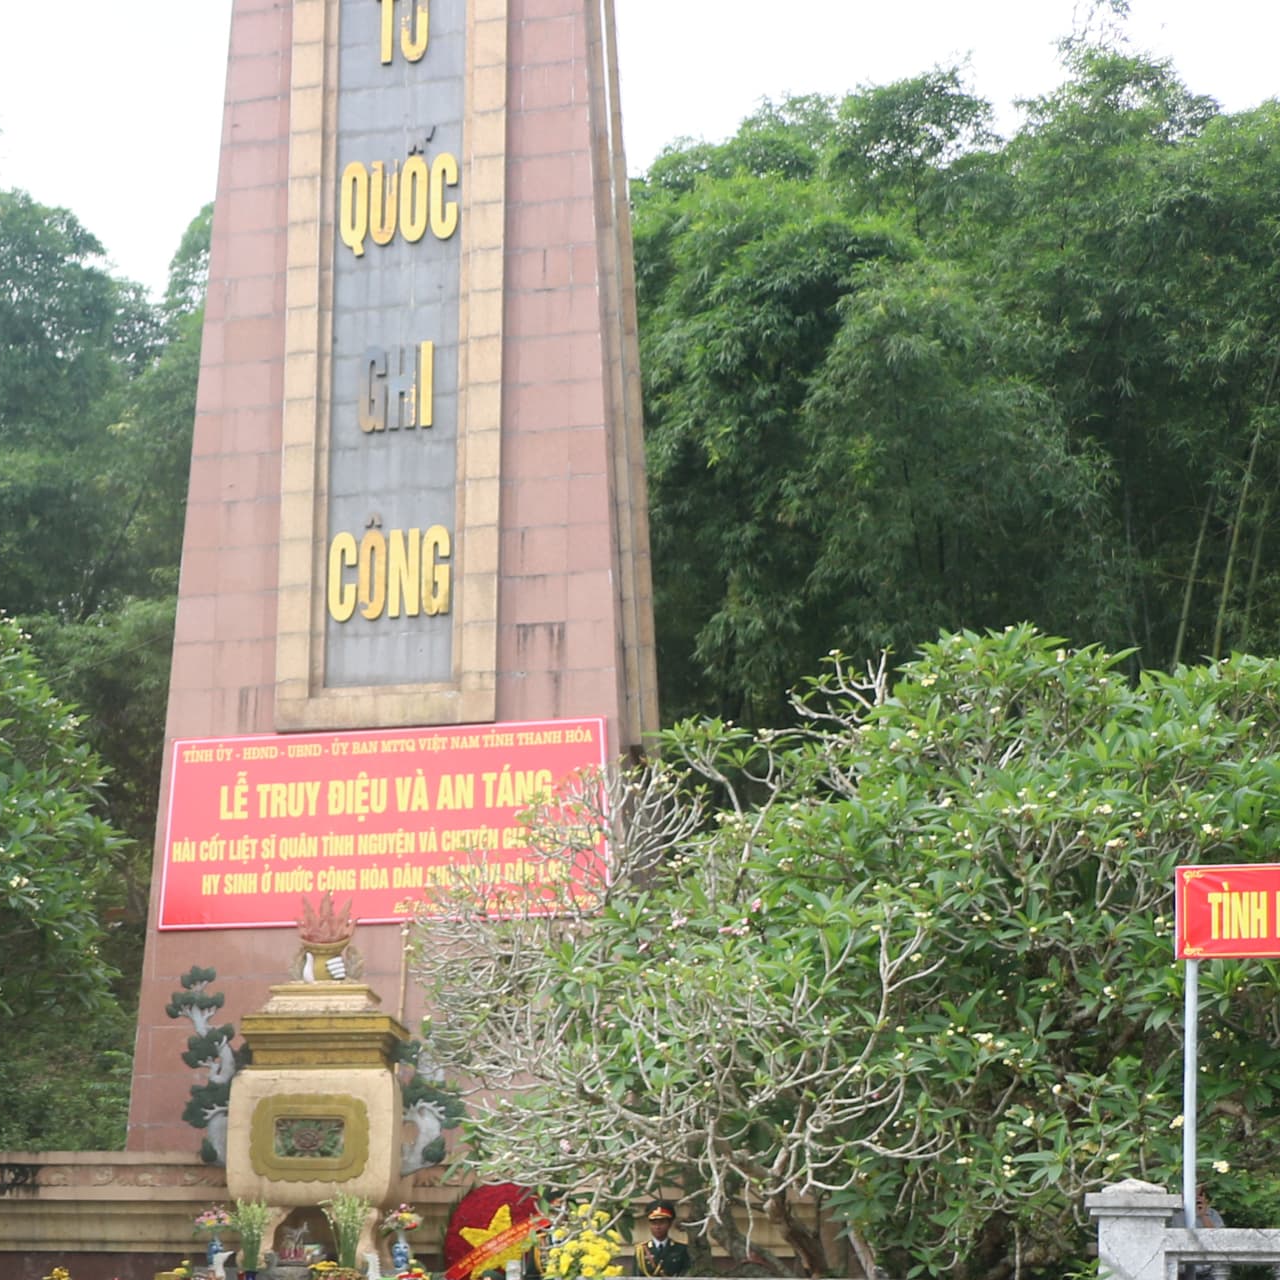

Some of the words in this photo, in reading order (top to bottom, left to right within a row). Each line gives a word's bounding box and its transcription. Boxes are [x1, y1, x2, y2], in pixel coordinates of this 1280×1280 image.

[340, 126, 459, 258] QUỐC
[358, 340, 433, 433] GHI
[328, 511, 450, 622] CÔNG
[184, 746, 214, 764] TỈNH
[216, 744, 233, 762] ỦY
[243, 746, 278, 760] HĐND
[287, 743, 322, 758] UBND
[331, 738, 350, 756] ỦY
[352, 741, 379, 754] BAN
[381, 739, 416, 753] MTTQ
[419, 733, 448, 754] VIỆT
[450, 735, 480, 750] NAM
[482, 728, 514, 747] TỈNH
[518, 729, 562, 746] THANH
[565, 726, 593, 744] HÓA
[219, 771, 249, 820] LỄ
[256, 781, 321, 819] TRUY
[327, 771, 387, 822] ĐIỆU
[395, 768, 429, 812] VÀ
[436, 773, 475, 811] AN
[482, 763, 552, 809] TÁNG
[172, 837, 196, 862] HÀI
[199, 833, 226, 861] CỐT
[229, 835, 258, 864] LIỆT
[261, 834, 276, 859] SĨ
[279, 832, 318, 860] QUÂN
[322, 831, 354, 857] TÌNH
[358, 828, 415, 858] NGUYỆN
[419, 827, 438, 852] VÀ
[202, 873, 220, 895] HY
[224, 872, 258, 894] SINH
[274, 866, 313, 892] NƯỚC
[317, 866, 356, 895] CỘNG
[360, 863, 389, 890] HÒA
[393, 861, 423, 889] DÂN
[1207, 881, 1268, 939] TÌNH
